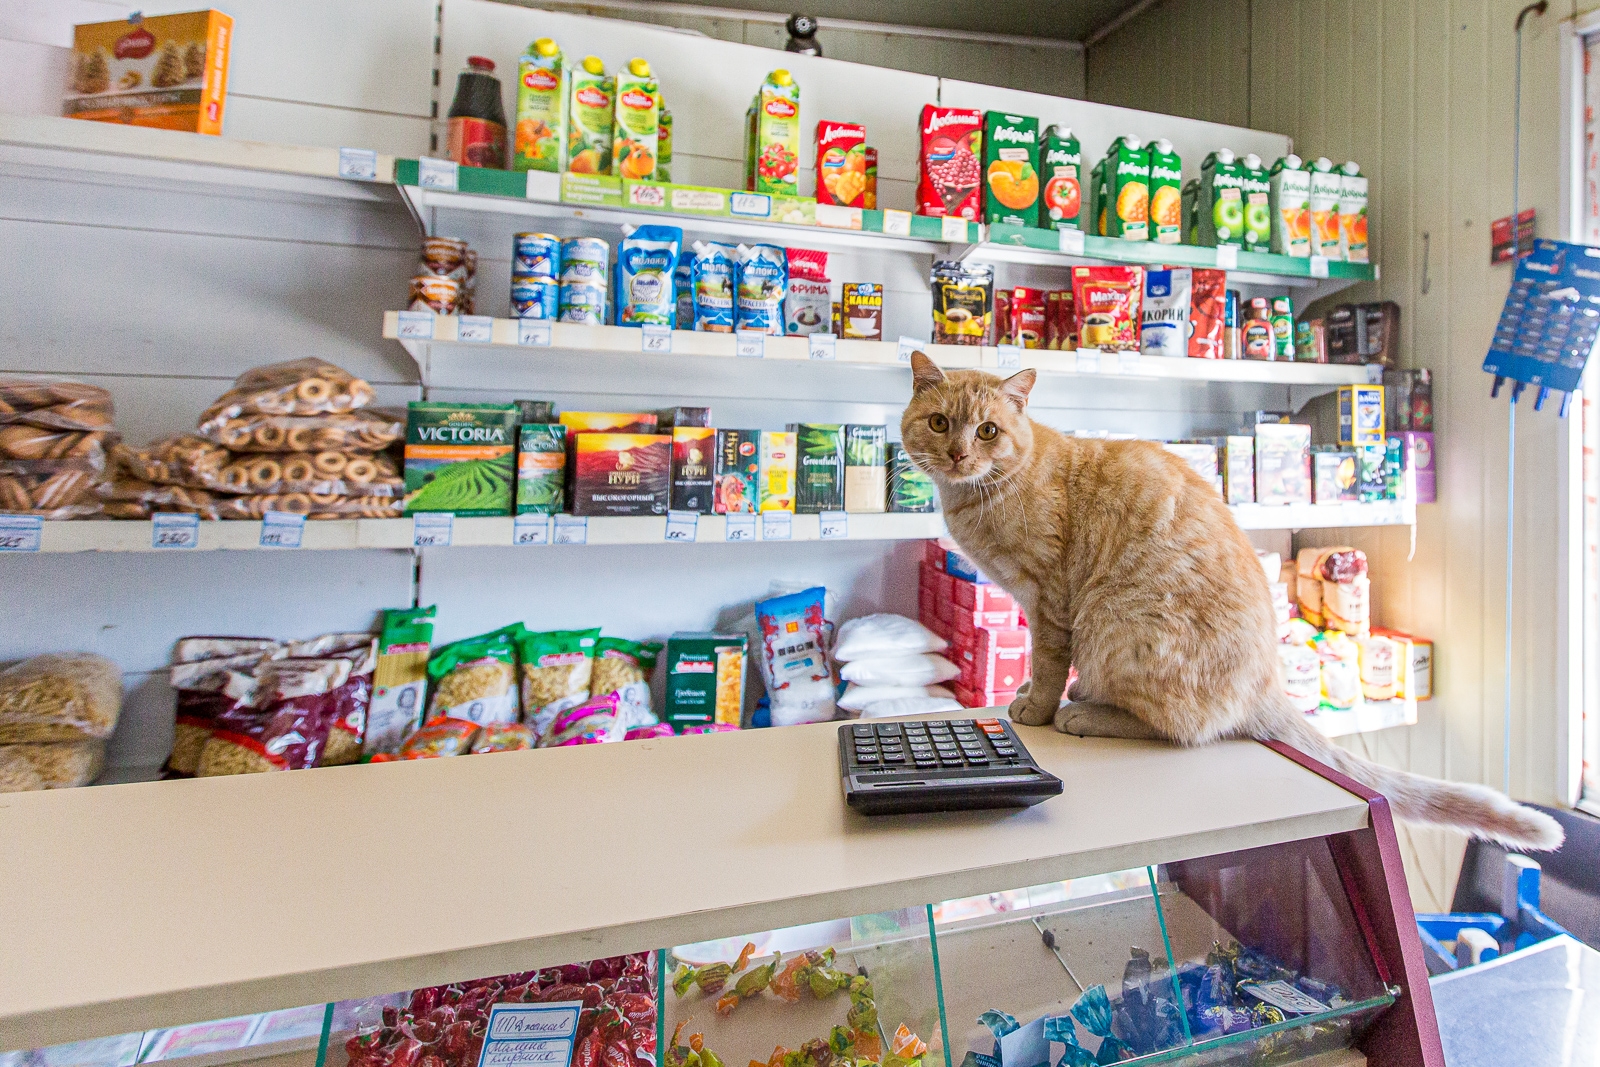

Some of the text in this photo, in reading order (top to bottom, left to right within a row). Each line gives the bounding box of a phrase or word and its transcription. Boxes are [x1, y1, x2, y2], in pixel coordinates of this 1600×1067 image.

[924, 111, 979, 134] Любимый
[820, 125, 864, 145] Любимый
[994, 125, 1036, 144] Добрый
[1046, 149, 1081, 165] Добрый
[632, 255, 667, 266] МОЛОКО
[745, 265, 778, 276] МОЛОКО
[789, 283, 829, 295] ФРИМА
[849, 295, 882, 306] КАКАО
[1091, 288, 1127, 303] Maxim
[1142, 306, 1184, 321] ИКОРИЙ
[417, 427, 505, 442] VICTORIA
[853, 427, 884, 437] Greenfield
[803, 455, 838, 466] Greenfield
[681, 468, 707, 476] НУРИ
[608, 475, 640, 485] НУРИ
[592, 494, 654, 502] ВЫСОКОГОРНЫЙ
